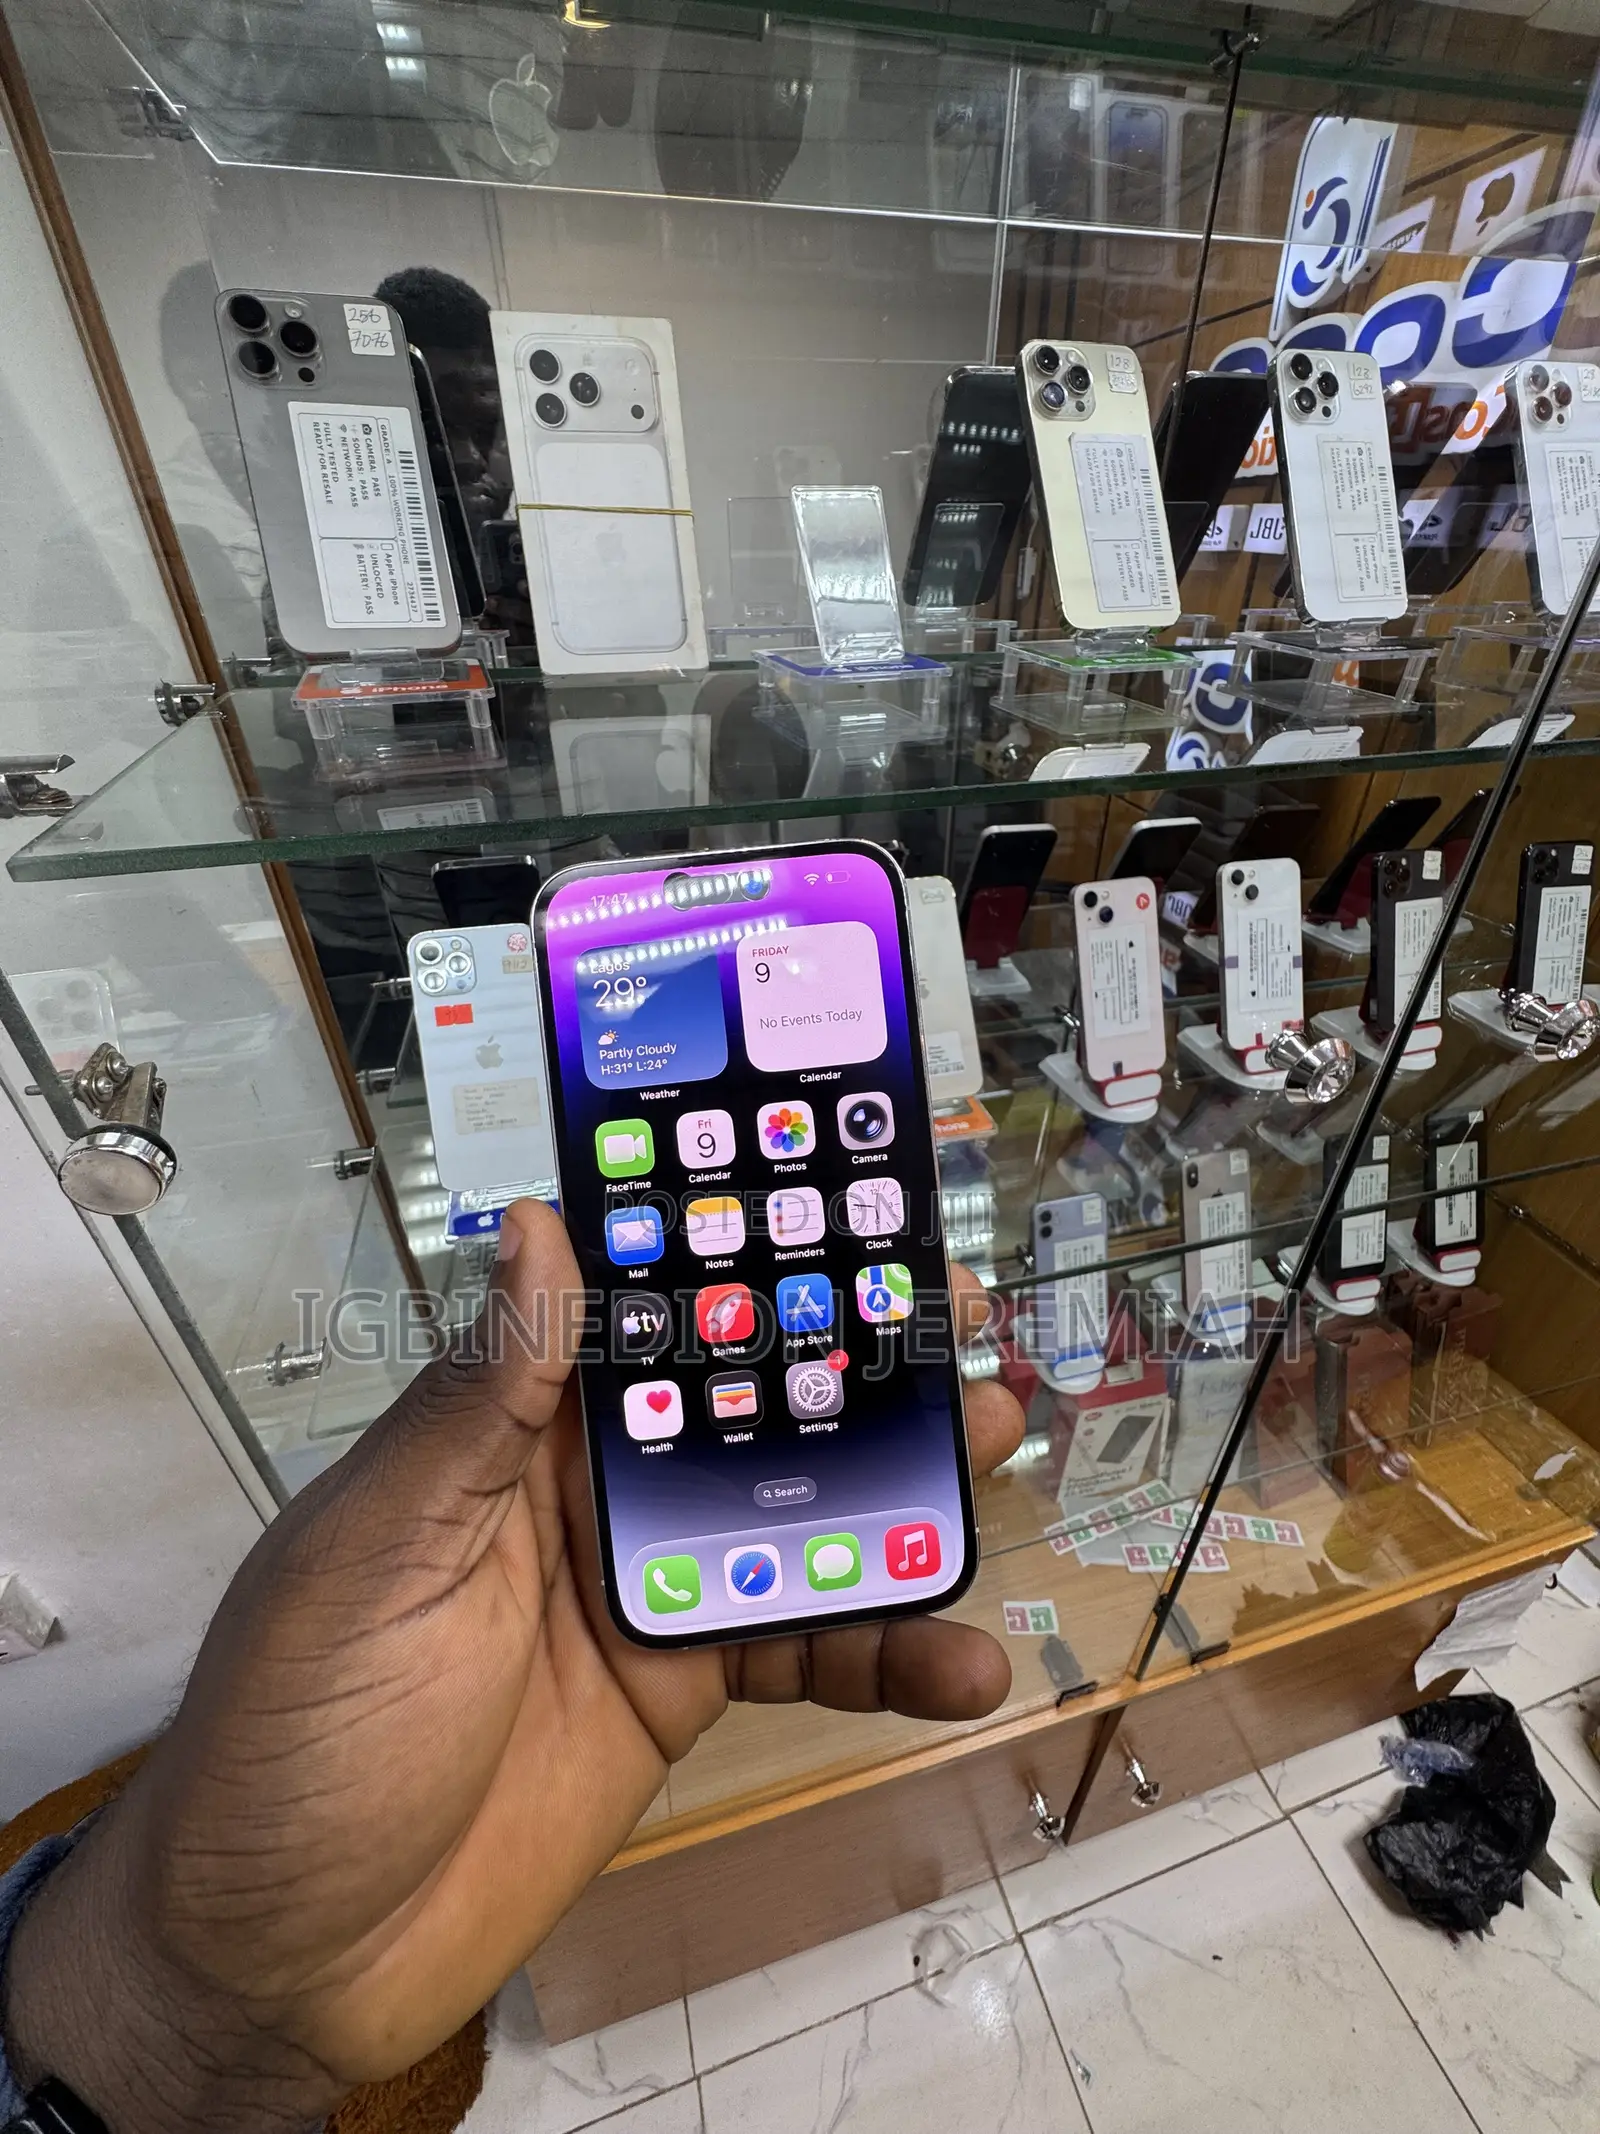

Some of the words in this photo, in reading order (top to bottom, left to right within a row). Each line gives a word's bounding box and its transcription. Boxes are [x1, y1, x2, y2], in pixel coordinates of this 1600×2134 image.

[348, 307, 382, 324] 256
[350, 331, 389, 348] 7076
[311, 421, 324, 450] READY
[322, 421, 333, 448] FULLY
[378, 423, 392, 456] GRADE:
[317, 452, 327, 470] FOR
[327, 450, 339, 483] TESTED
[350, 436, 365, 475] SOUNDS:
[358, 479, 369, 500] PASS
[363, 437, 377, 473] CAMERA:
[370, 476, 381, 497] PASS
[384, 457, 393, 465] A
[339, 435, 354, 482] NETWORK:
[348, 486, 359, 507] PASS
[320, 472, 333, 504] RESALE
[387, 473, 398, 497] 100%
[391, 498, 405, 537] WORKING
[398, 538, 410, 564] PHONE
[355, 553, 370, 590] BATTERY:
[383, 552, 395, 575] Apple
[1123, 551, 1135, 588] UNLOCKED
[369, 552, 384, 599] UNLOCKED
[388, 578, 401, 606] iPhone
[362, 594, 374, 615] PASS
[371, 682, 449, 694] iPhone
[590, 893, 629, 908] 17:47
[751, 945, 790, 958] FRIDAY
[590, 959, 631, 975] Lagos
[754, 962, 771, 984] 9
[592, 975, 648, 1009] 29°
[759, 1017, 779, 1030] No
[780, 1013, 823, 1028] Events
[825, 1009, 864, 1026] Today
[599, 1046, 634, 1061] Partly
[636, 1042, 678, 1057] Cloudy
[600, 1061, 634, 1076] H:31°
[636, 1058, 668, 1072] L:24°
[799, 1070, 842, 1084] Calendar
[639, 1088, 681, 1101] Weather
[697, 1119, 713, 1129] Fri
[696, 1132, 717, 1158] 9
[851, 1152, 889, 1165] Camera
[773, 1161, 808, 1174] Photos
[688, 1170, 732, 1184] Calendar
[605, 1180, 652, 1193] FaceTime
[865, 1238, 893, 1250] Clock
[774, 1247, 825, 1261] Reminders
[705, 1257, 735, 1270] Notes
[628, 1267, 649, 1279] Mail
[640, 1311, 666, 1333] tv
[875, 1325, 902, 1337] Maps
[785, 1336, 805, 1349] App
[806, 1333, 834, 1346] Store
[712, 1345, 746, 1357] Games
[640, 1356, 655, 1366] TV
[799, 1420, 839, 1435] Settings
[723, 1431, 754, 1444] Wallet
[641, 1441, 674, 1455] Health
[774, 1484, 808, 1498] Search
